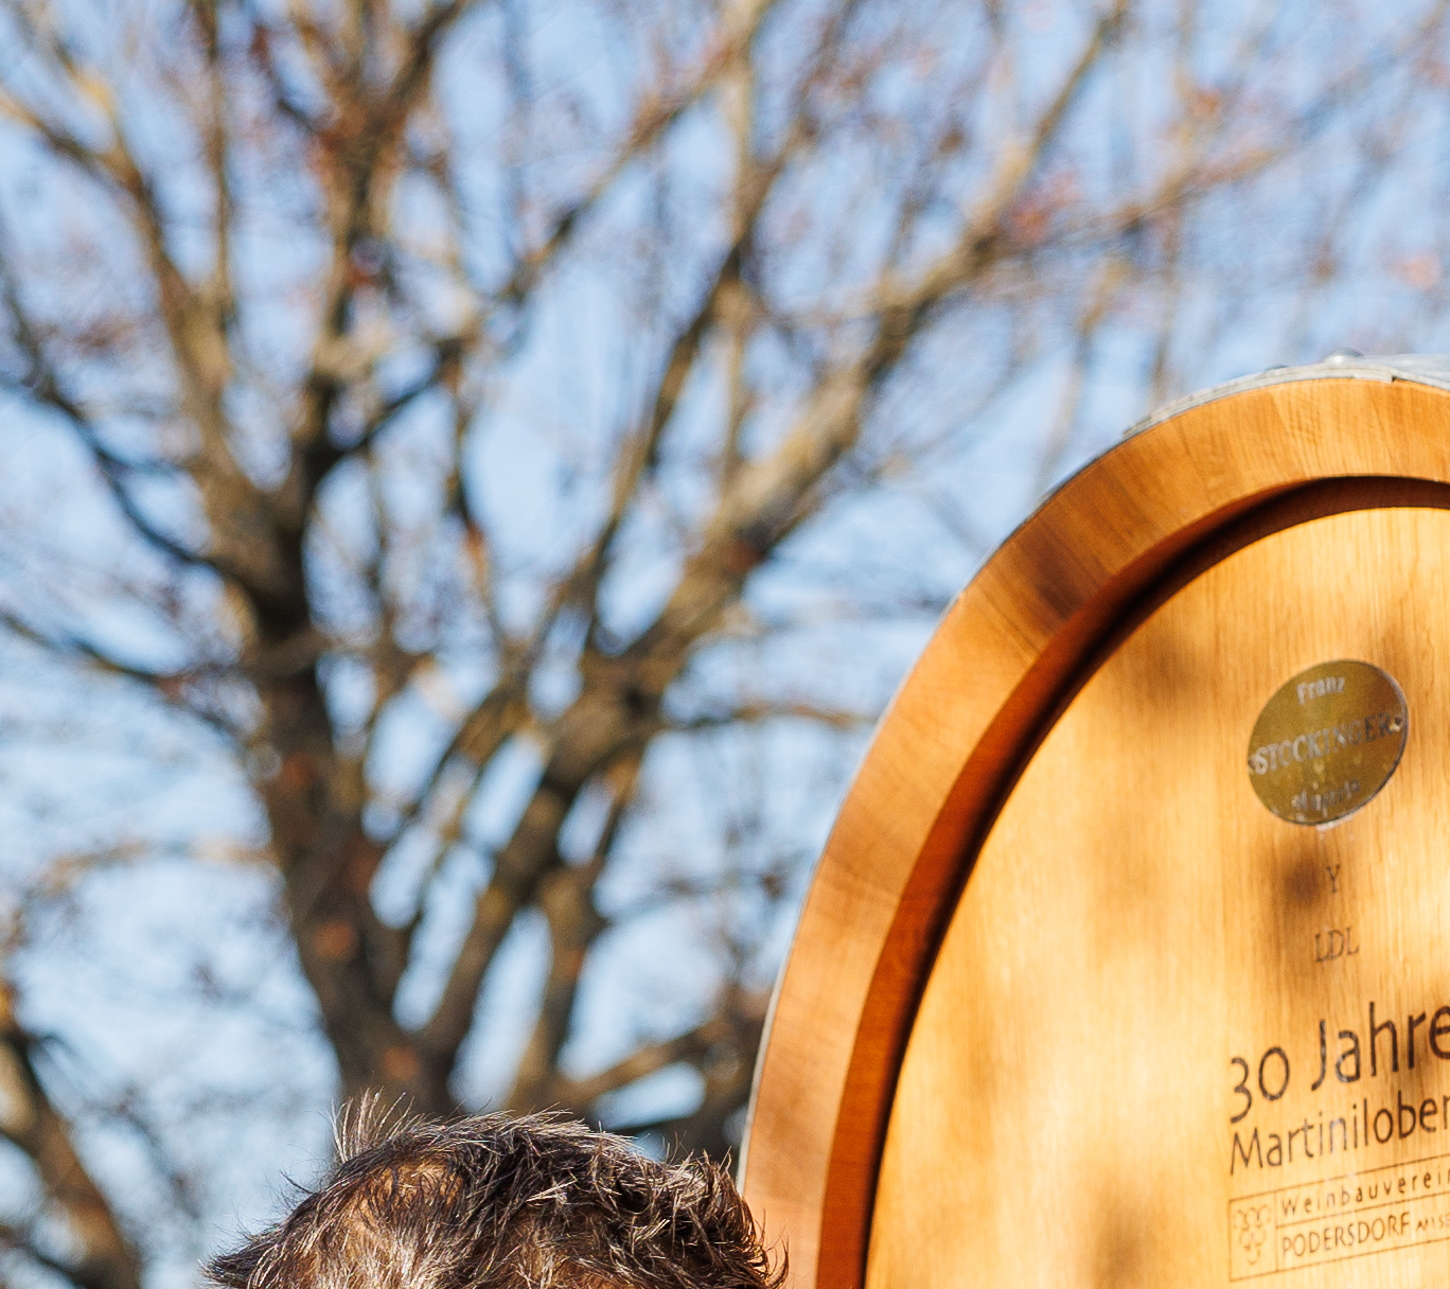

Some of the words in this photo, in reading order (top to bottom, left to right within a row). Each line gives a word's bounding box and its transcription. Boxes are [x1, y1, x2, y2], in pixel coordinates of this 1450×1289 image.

[1296, 677, 1346, 705] Franz
[1253, 711, 1394, 776] STOCKINGER
[1314, 926, 1360, 963] LDL
[1229, 1046, 1291, 1125] 30
[1281, 1211, 1411, 1260] PODERSDORF
